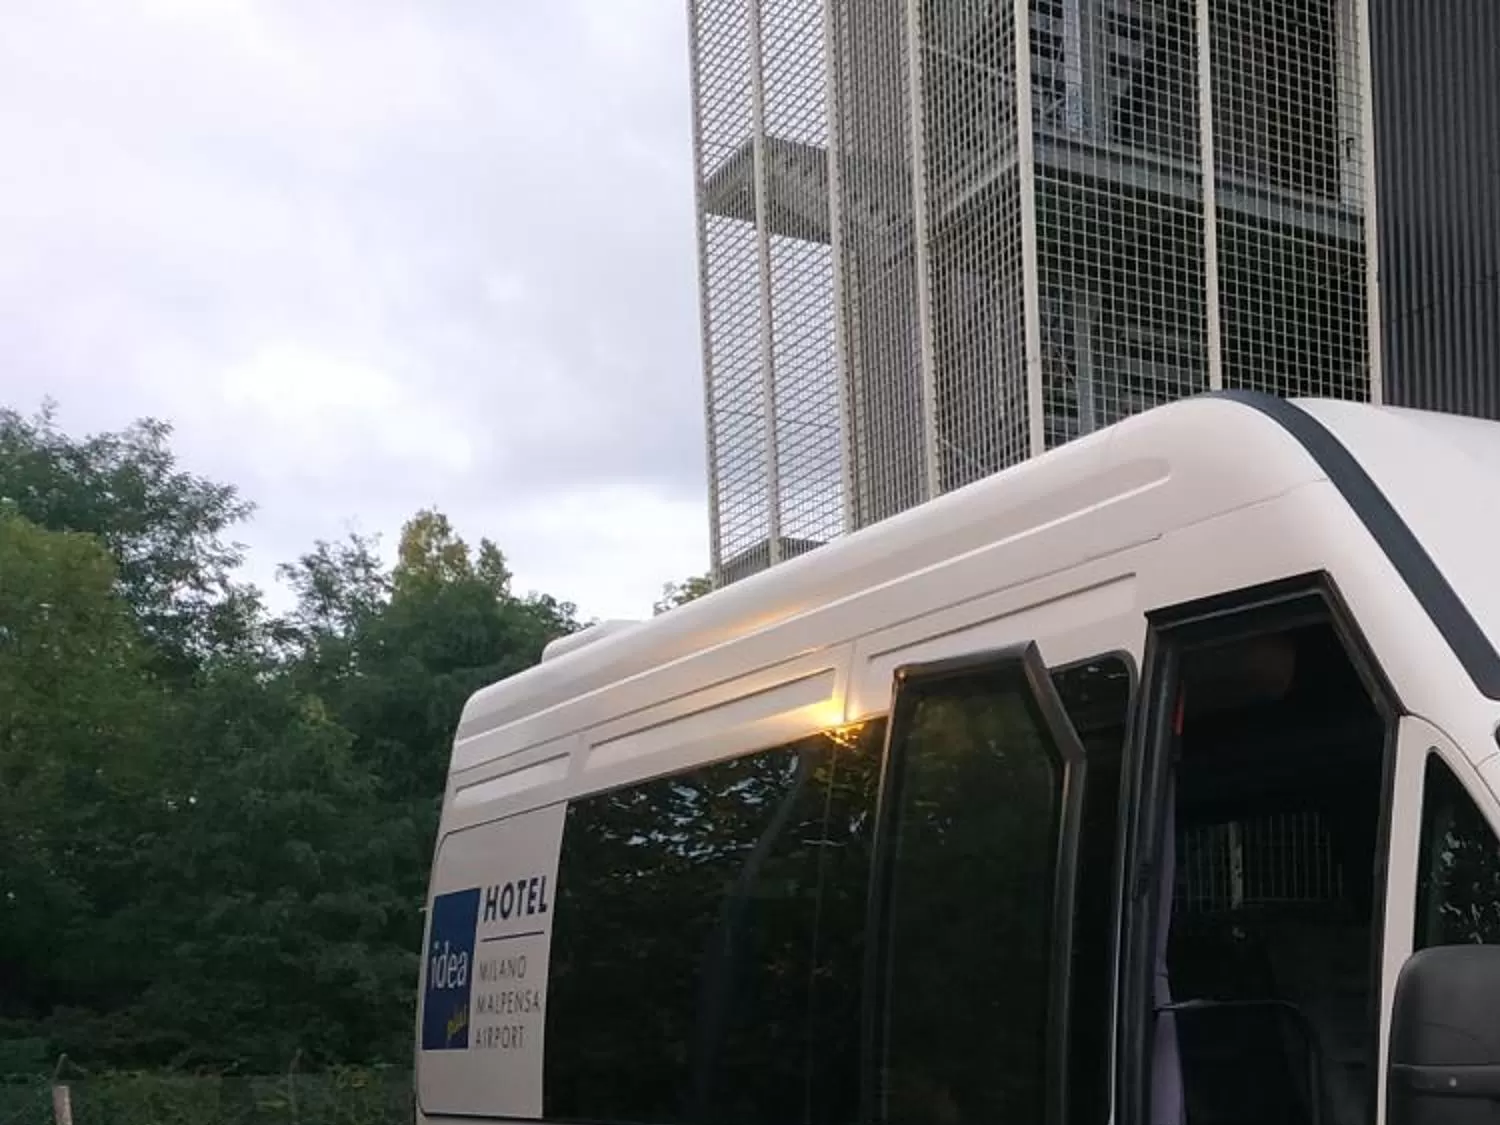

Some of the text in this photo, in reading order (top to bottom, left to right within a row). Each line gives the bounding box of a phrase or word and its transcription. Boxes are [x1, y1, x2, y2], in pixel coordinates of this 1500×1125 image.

[483, 875, 549, 923] HOTEL
[430, 939, 469, 990] idea
[478, 955, 527, 982] MILANO
[475, 989, 541, 1015] MALPENSA
[475, 1025, 525, 1049] AIRPORT
